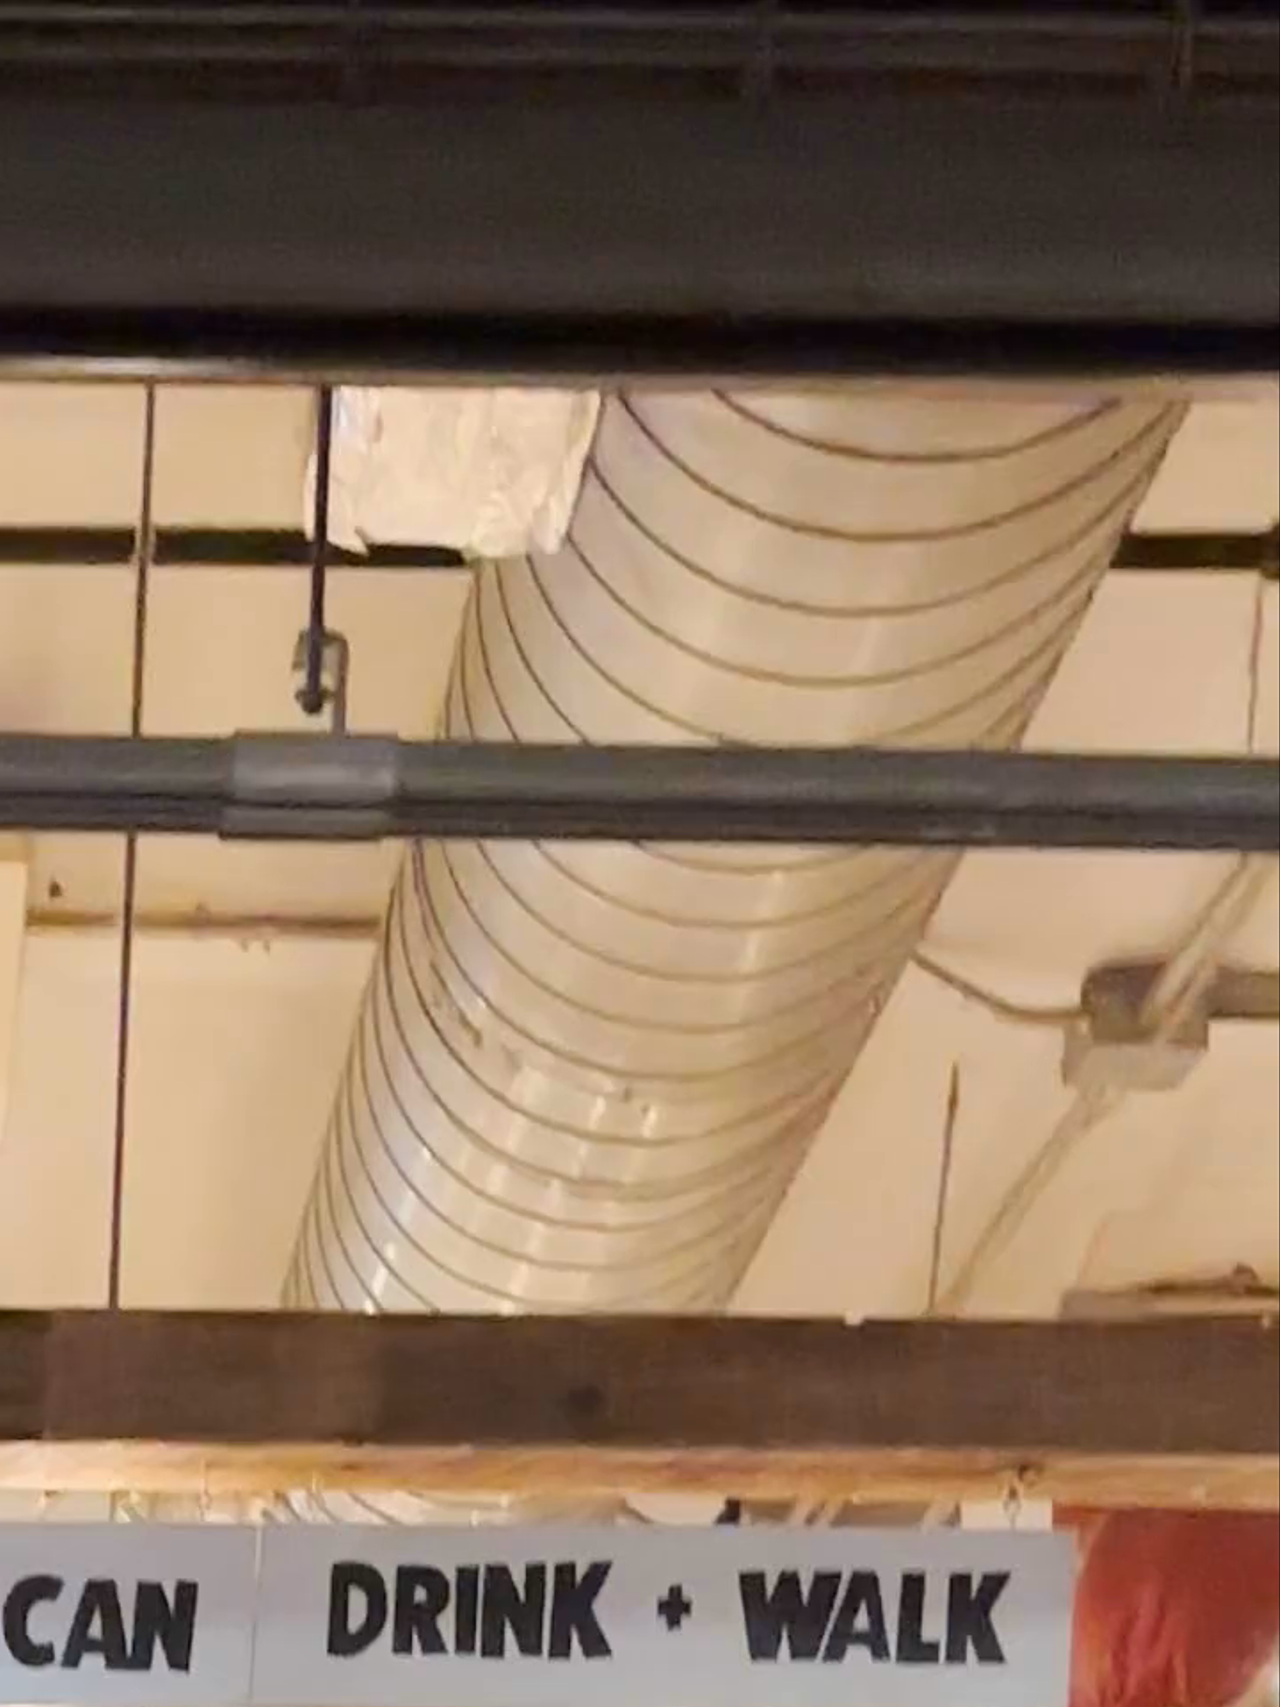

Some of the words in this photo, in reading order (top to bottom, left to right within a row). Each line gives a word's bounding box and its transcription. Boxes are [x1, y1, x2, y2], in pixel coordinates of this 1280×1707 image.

[1, 1574, 200, 1673] CAN
[326, 1560, 613, 1660] DRINK
[739, 1570, 1012, 1664] WALK
